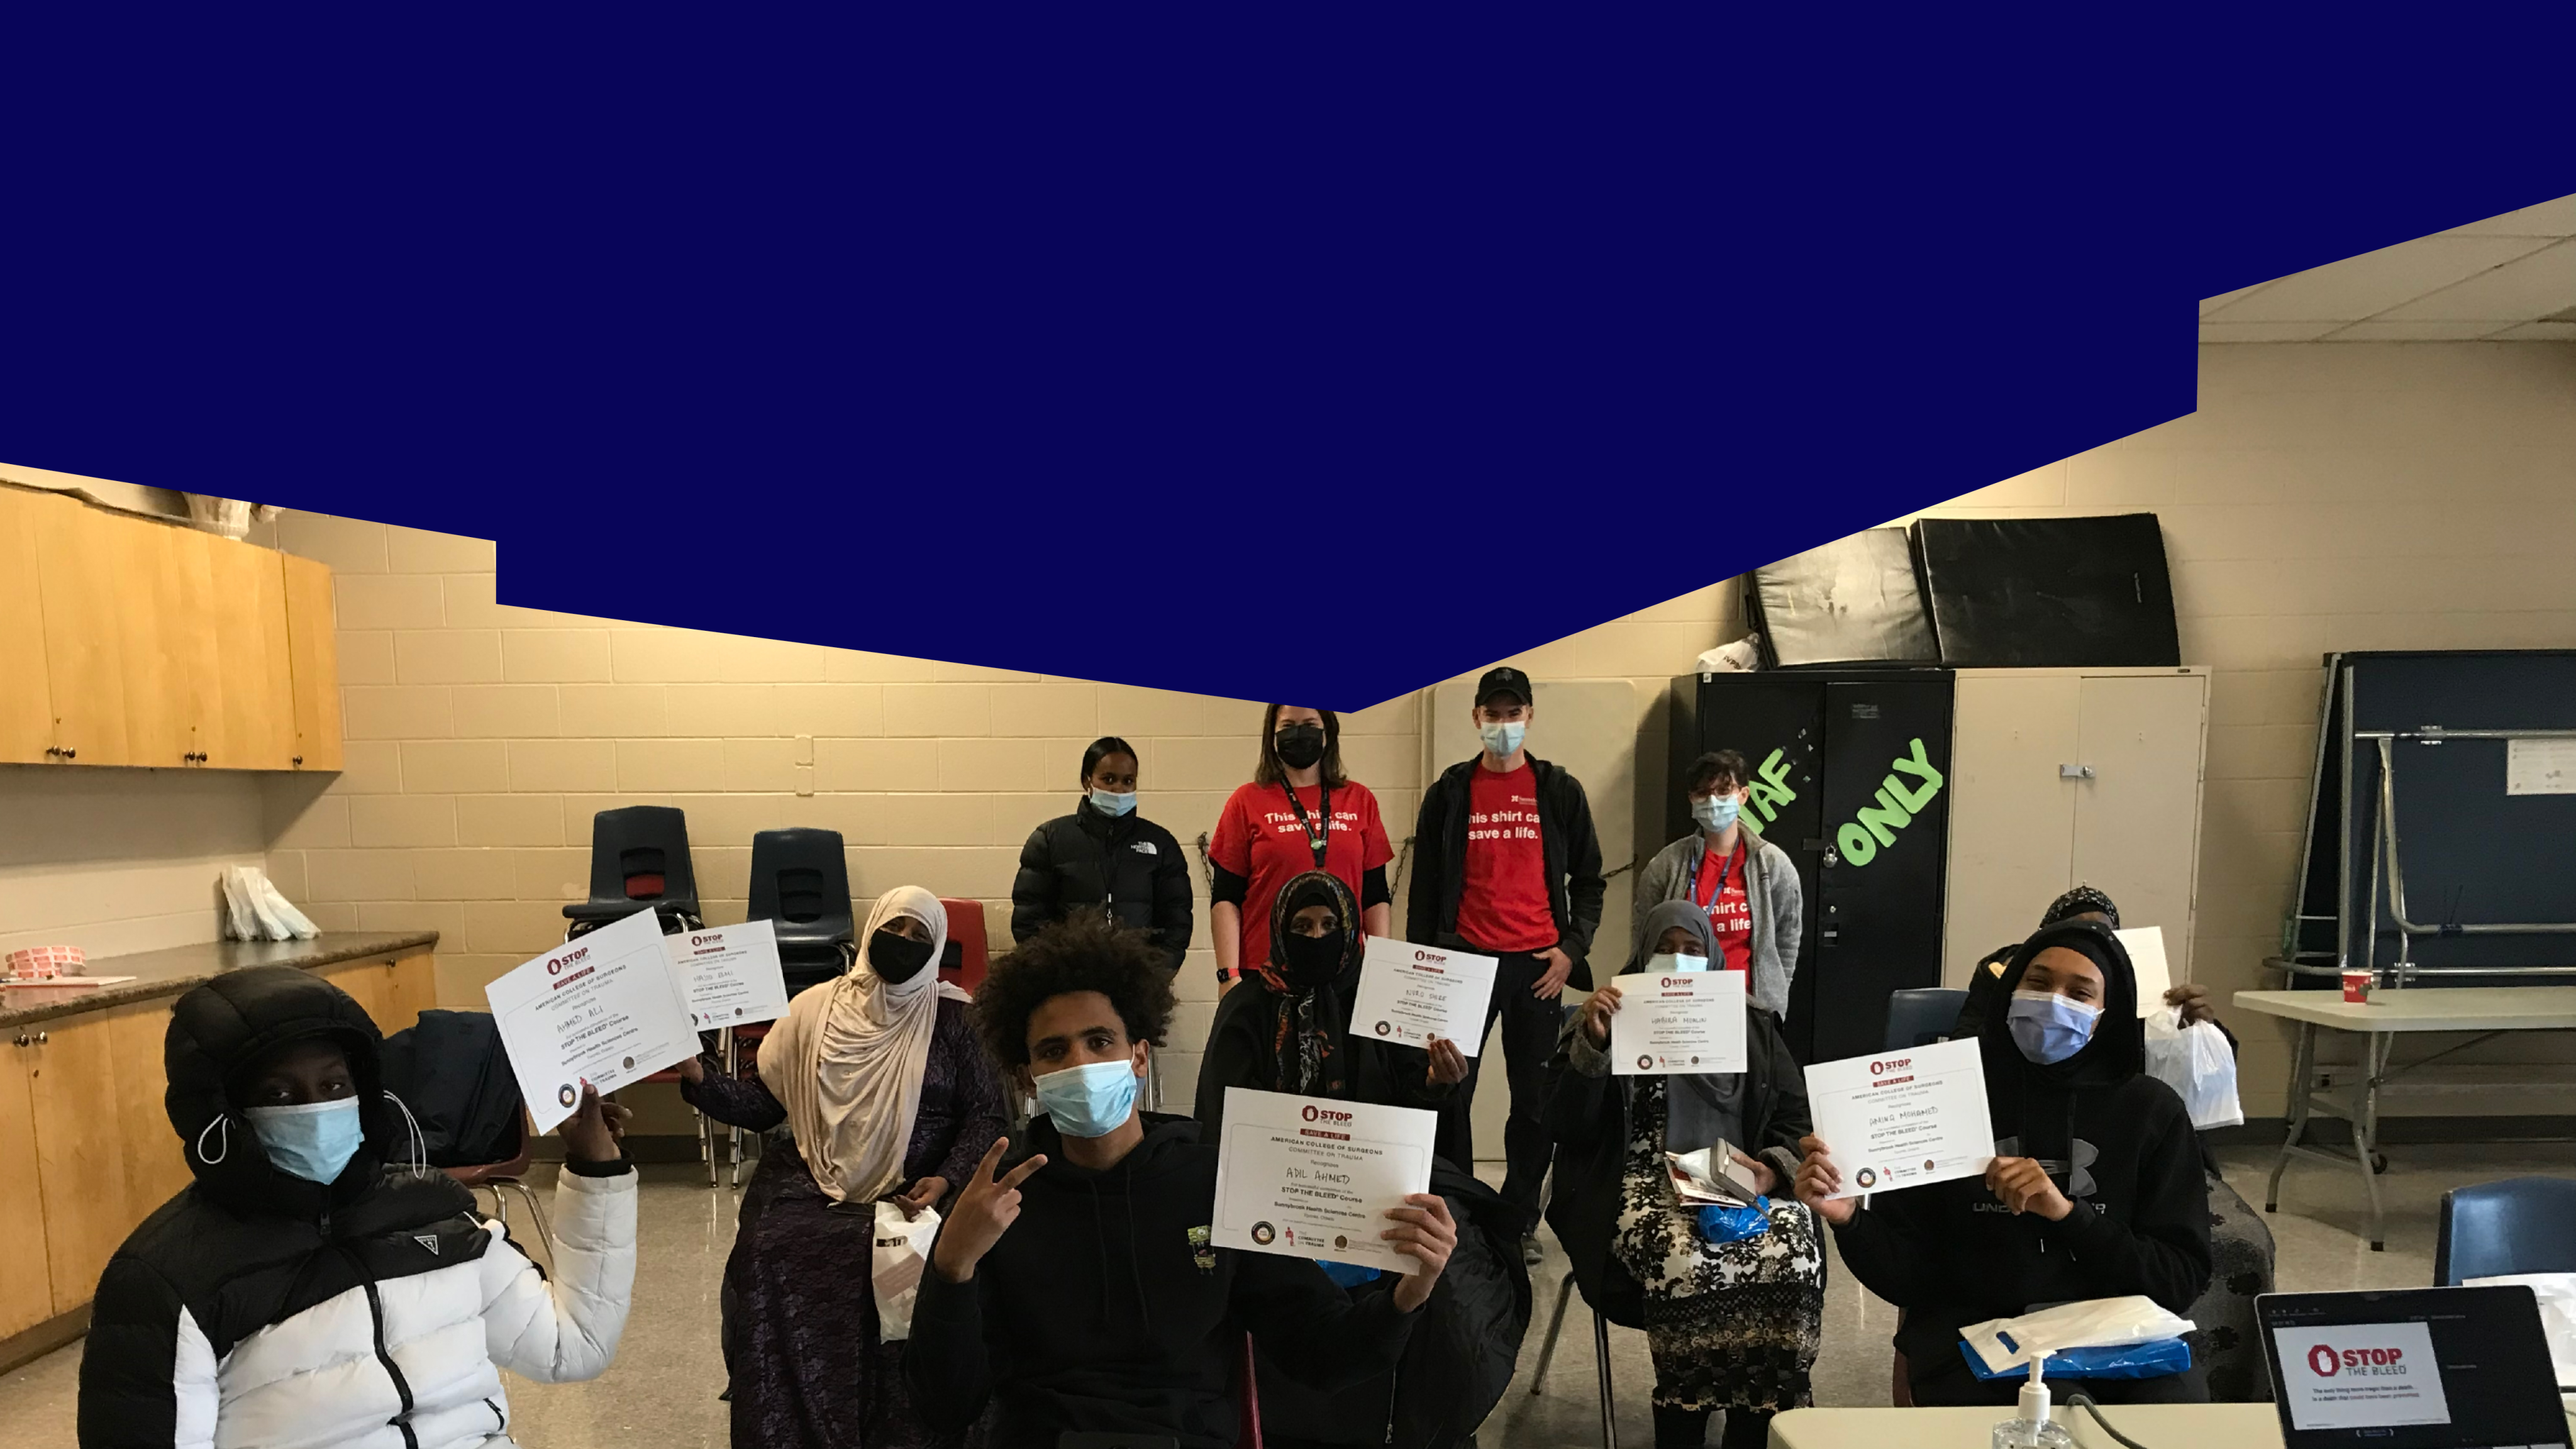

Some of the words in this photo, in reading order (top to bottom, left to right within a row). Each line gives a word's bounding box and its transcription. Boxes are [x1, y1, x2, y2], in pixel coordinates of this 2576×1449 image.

[1837, 738, 1943, 867] ONLY
[1264, 813, 1296, 824] This
[1335, 811, 1358, 820] can
[1492, 811, 1522, 822] shirt
[1526, 813, 1540, 823] ca
[1468, 830, 1499, 840] save
[1503, 830, 1511, 838] a
[1516, 827, 1538, 839] life.
[1717, 923, 1725, 932] a
[561, 947, 589, 965] STOP
[1426, 953, 1446, 962] STOP
[535, 994, 561, 1011] AMERICAN
[562, 982, 586, 997] COLLEGE
[596, 963, 626, 982] SURGEONS
[550, 993, 580, 1011] COMMITTEE
[591, 977, 613, 992] TRAUMA
[556, 1014, 582, 1033] AHMED
[588, 1004, 603, 1018] ALI
[560, 1038, 575, 1050] STOP
[575, 1033, 587, 1042] THE
[609, 1013, 628, 1027] Course
[1885, 1058, 1911, 1069] STOP
[1852, 1091, 1879, 1099] AMERICAN
[1880, 1087, 1904, 1095] COLLEGE
[1914, 1080, 1943, 1089] SURGEONS
[1320, 1109, 1352, 1121] STOP
[1869, 1114, 1895, 1126] AMINA
[1899, 1106, 1938, 1119] MOHAMED
[1270, 1136, 1304, 1145] AMERICAN
[1306, 1141, 1335, 1149] COLLEGE
[1347, 1146, 1382, 1155] SURGEONS
[1289, 1147, 1324, 1156] COMMITTEE
[1286, 1167, 1307, 1179] ADIL
[1314, 1170, 1350, 1185] AHMED
[1281, 1186, 1298, 1194] STOP
[1340, 1194, 1362, 1202] Course
[1274, 1201, 1304, 1211] Sunnybrook
[2343, 1348, 2402, 1367] STOP
[2346, 1367, 2367, 1376] THE
[2372, 1365, 2406, 1375] BLEED
